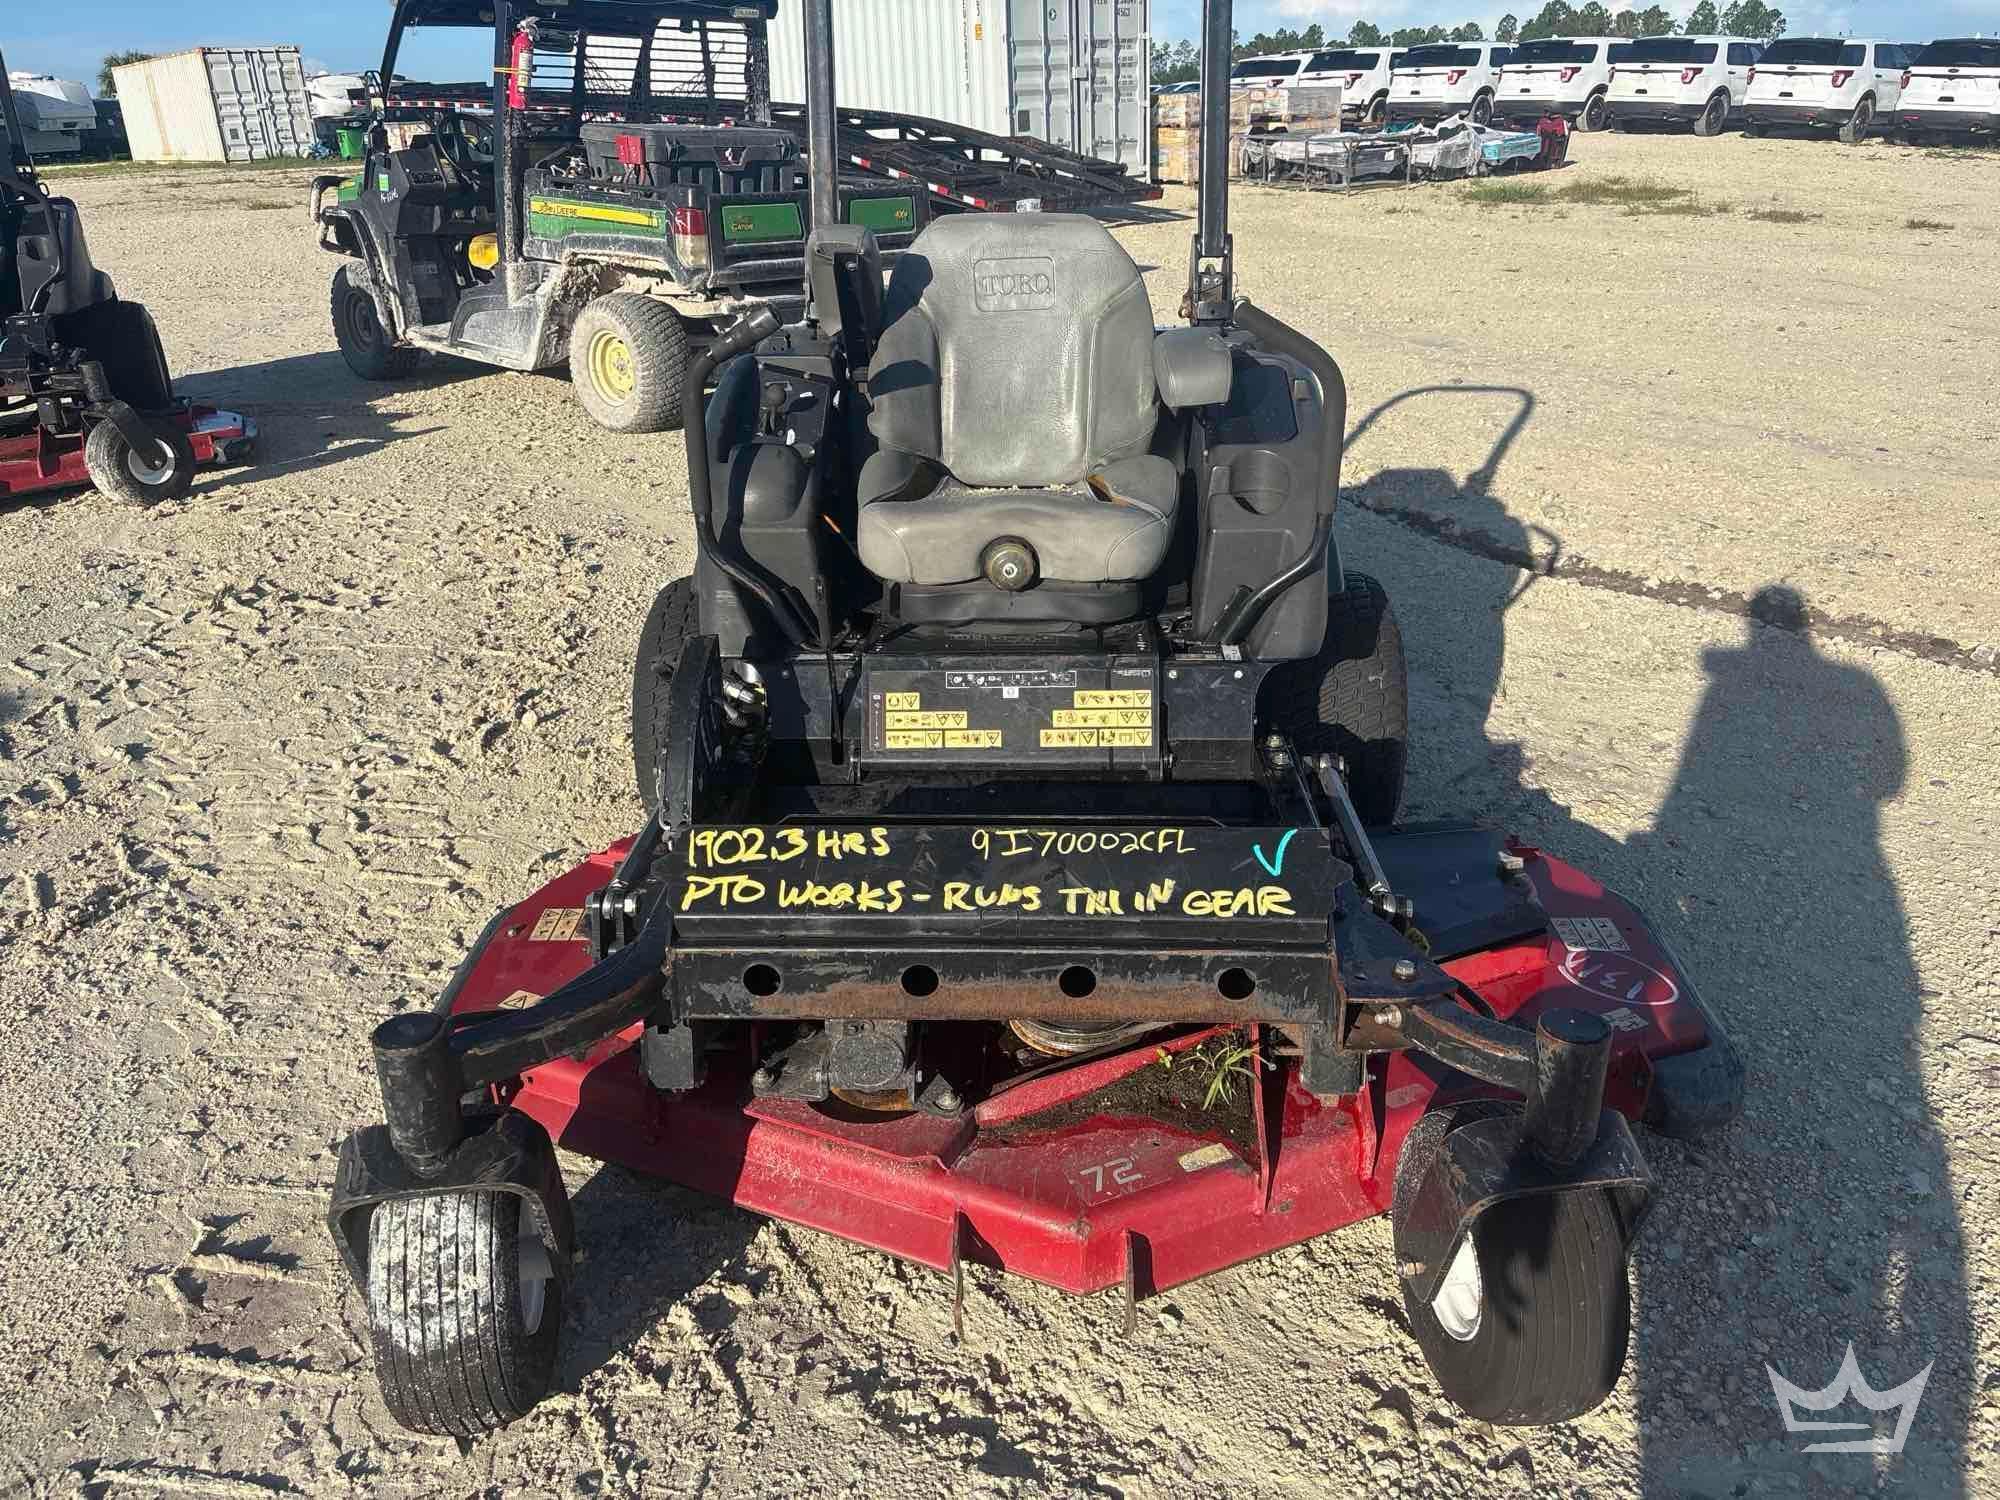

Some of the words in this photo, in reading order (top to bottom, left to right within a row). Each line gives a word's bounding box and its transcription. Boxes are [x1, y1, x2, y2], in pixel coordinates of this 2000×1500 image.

[981, 273, 1050, 295] TORO
[688, 827, 809, 868] 1902.3
[817, 826, 891, 860] HRS
[681, 874, 766, 912] PTO
[778, 879, 906, 913] WORKS
[943, 881, 1042, 912] RUNS
[1182, 886, 1296, 918] GEAR
